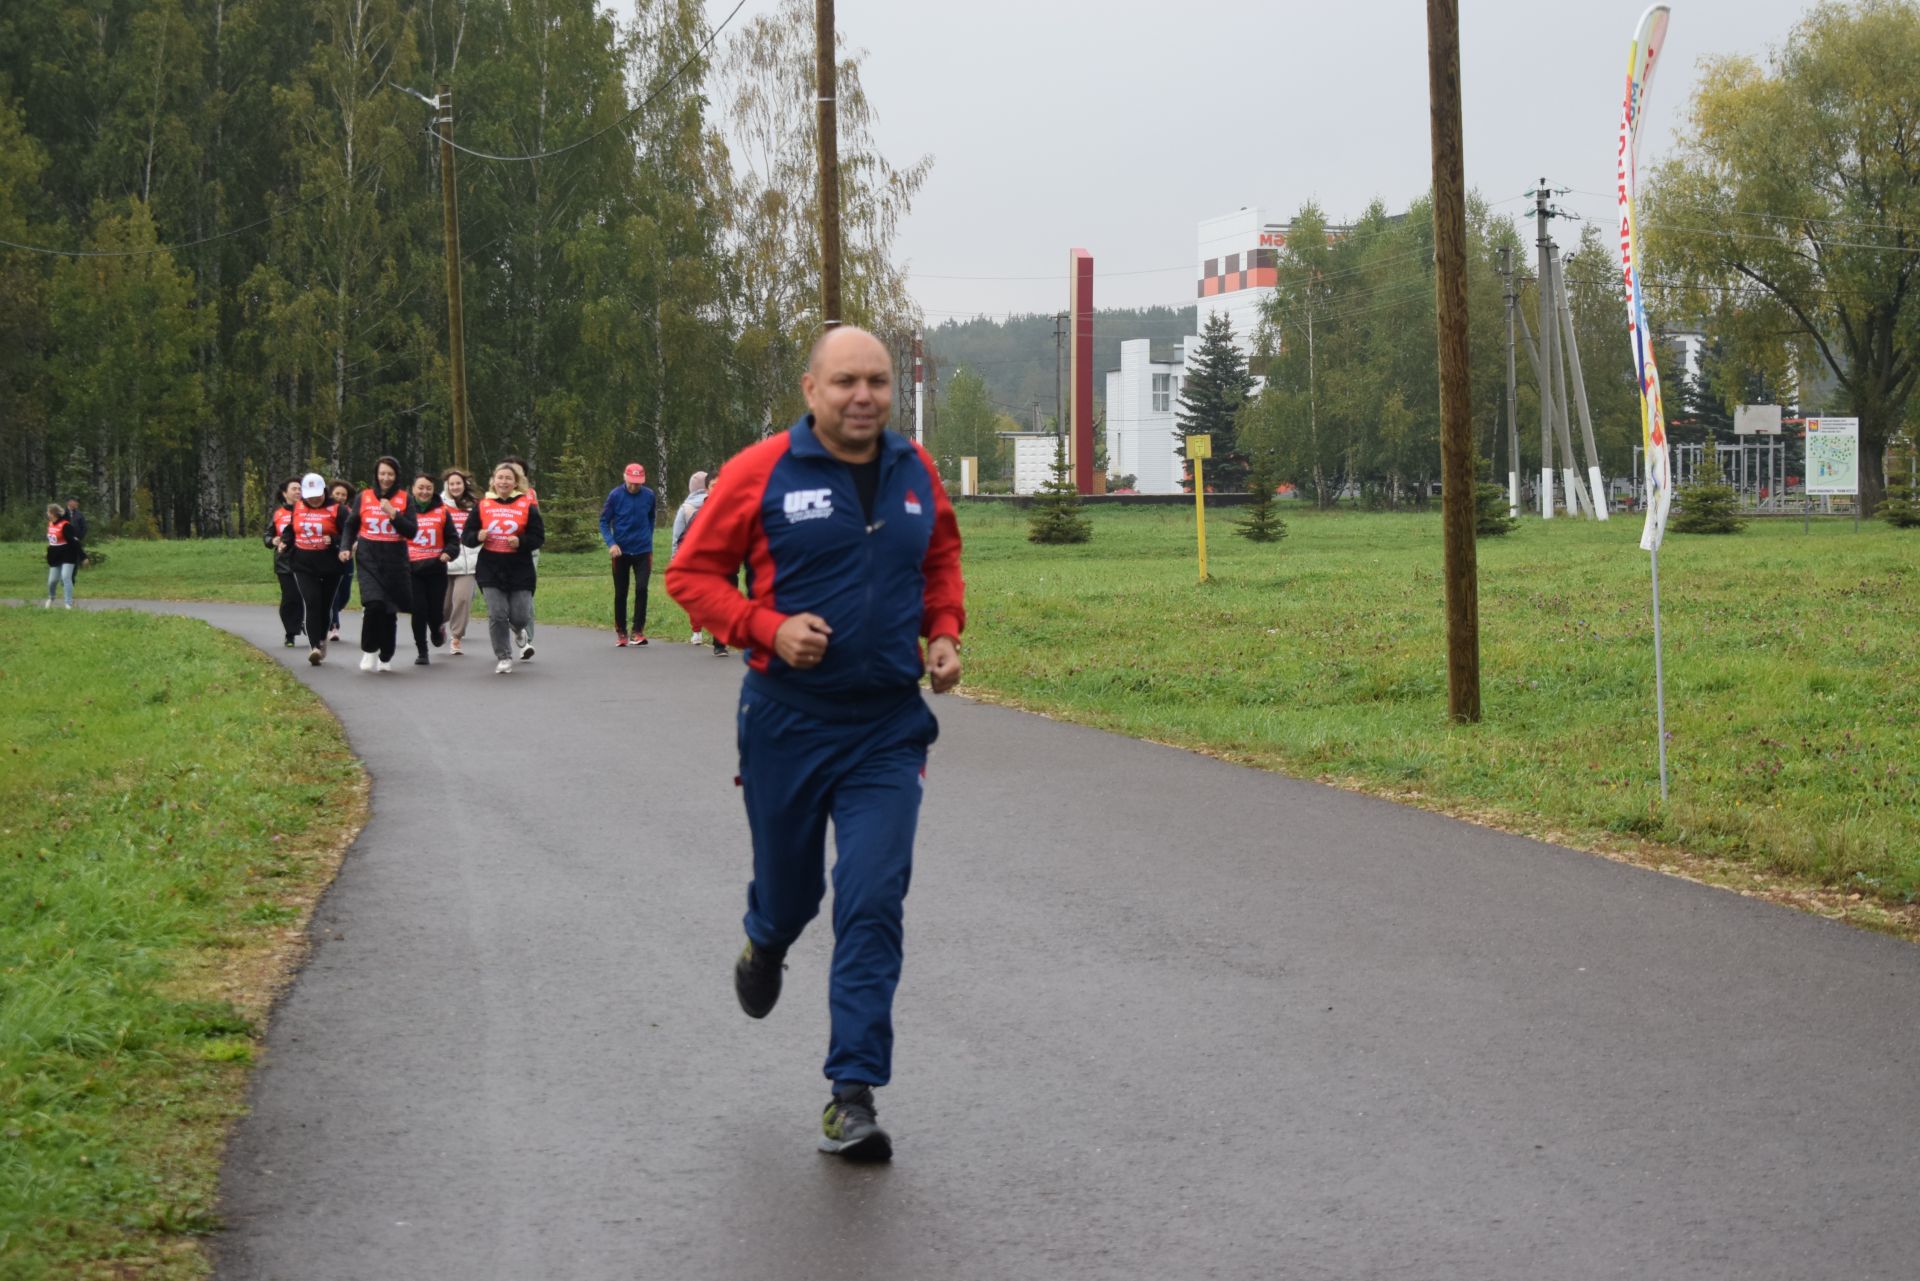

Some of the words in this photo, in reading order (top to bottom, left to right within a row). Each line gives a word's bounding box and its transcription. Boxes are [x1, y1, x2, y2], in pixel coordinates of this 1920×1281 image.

[783, 488, 832, 513] UFC
[298, 522, 323, 538] 31
[487, 519, 519, 534] 42
[412, 528, 437, 546] 41
